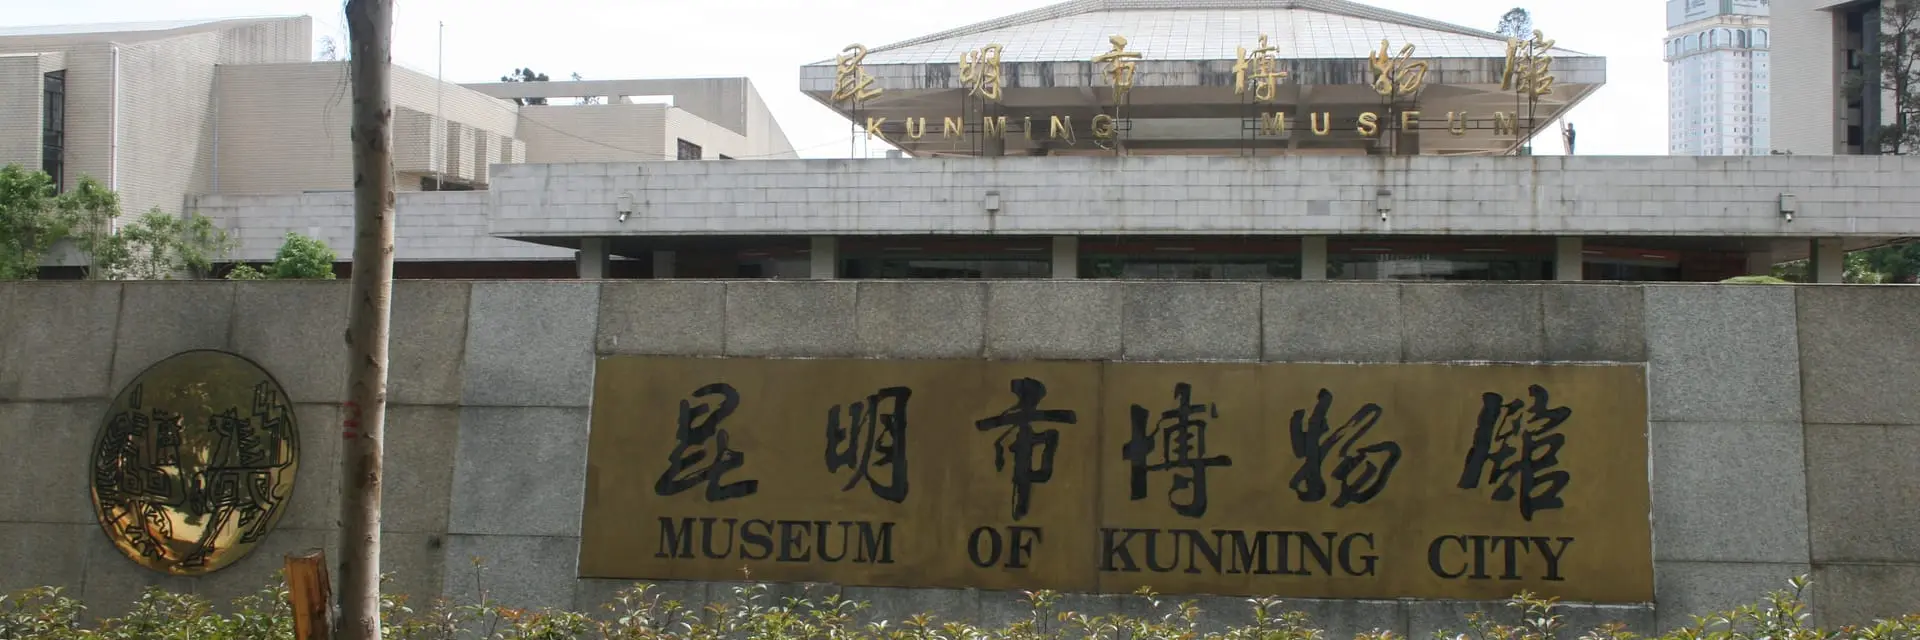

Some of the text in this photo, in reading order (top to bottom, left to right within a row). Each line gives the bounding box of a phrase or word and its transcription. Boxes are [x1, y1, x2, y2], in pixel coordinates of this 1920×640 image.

[867, 110, 1518, 140] KUNMING MUSEUM
[655, 516, 1575, 581] MUSEUM OF KUNMING CITY
